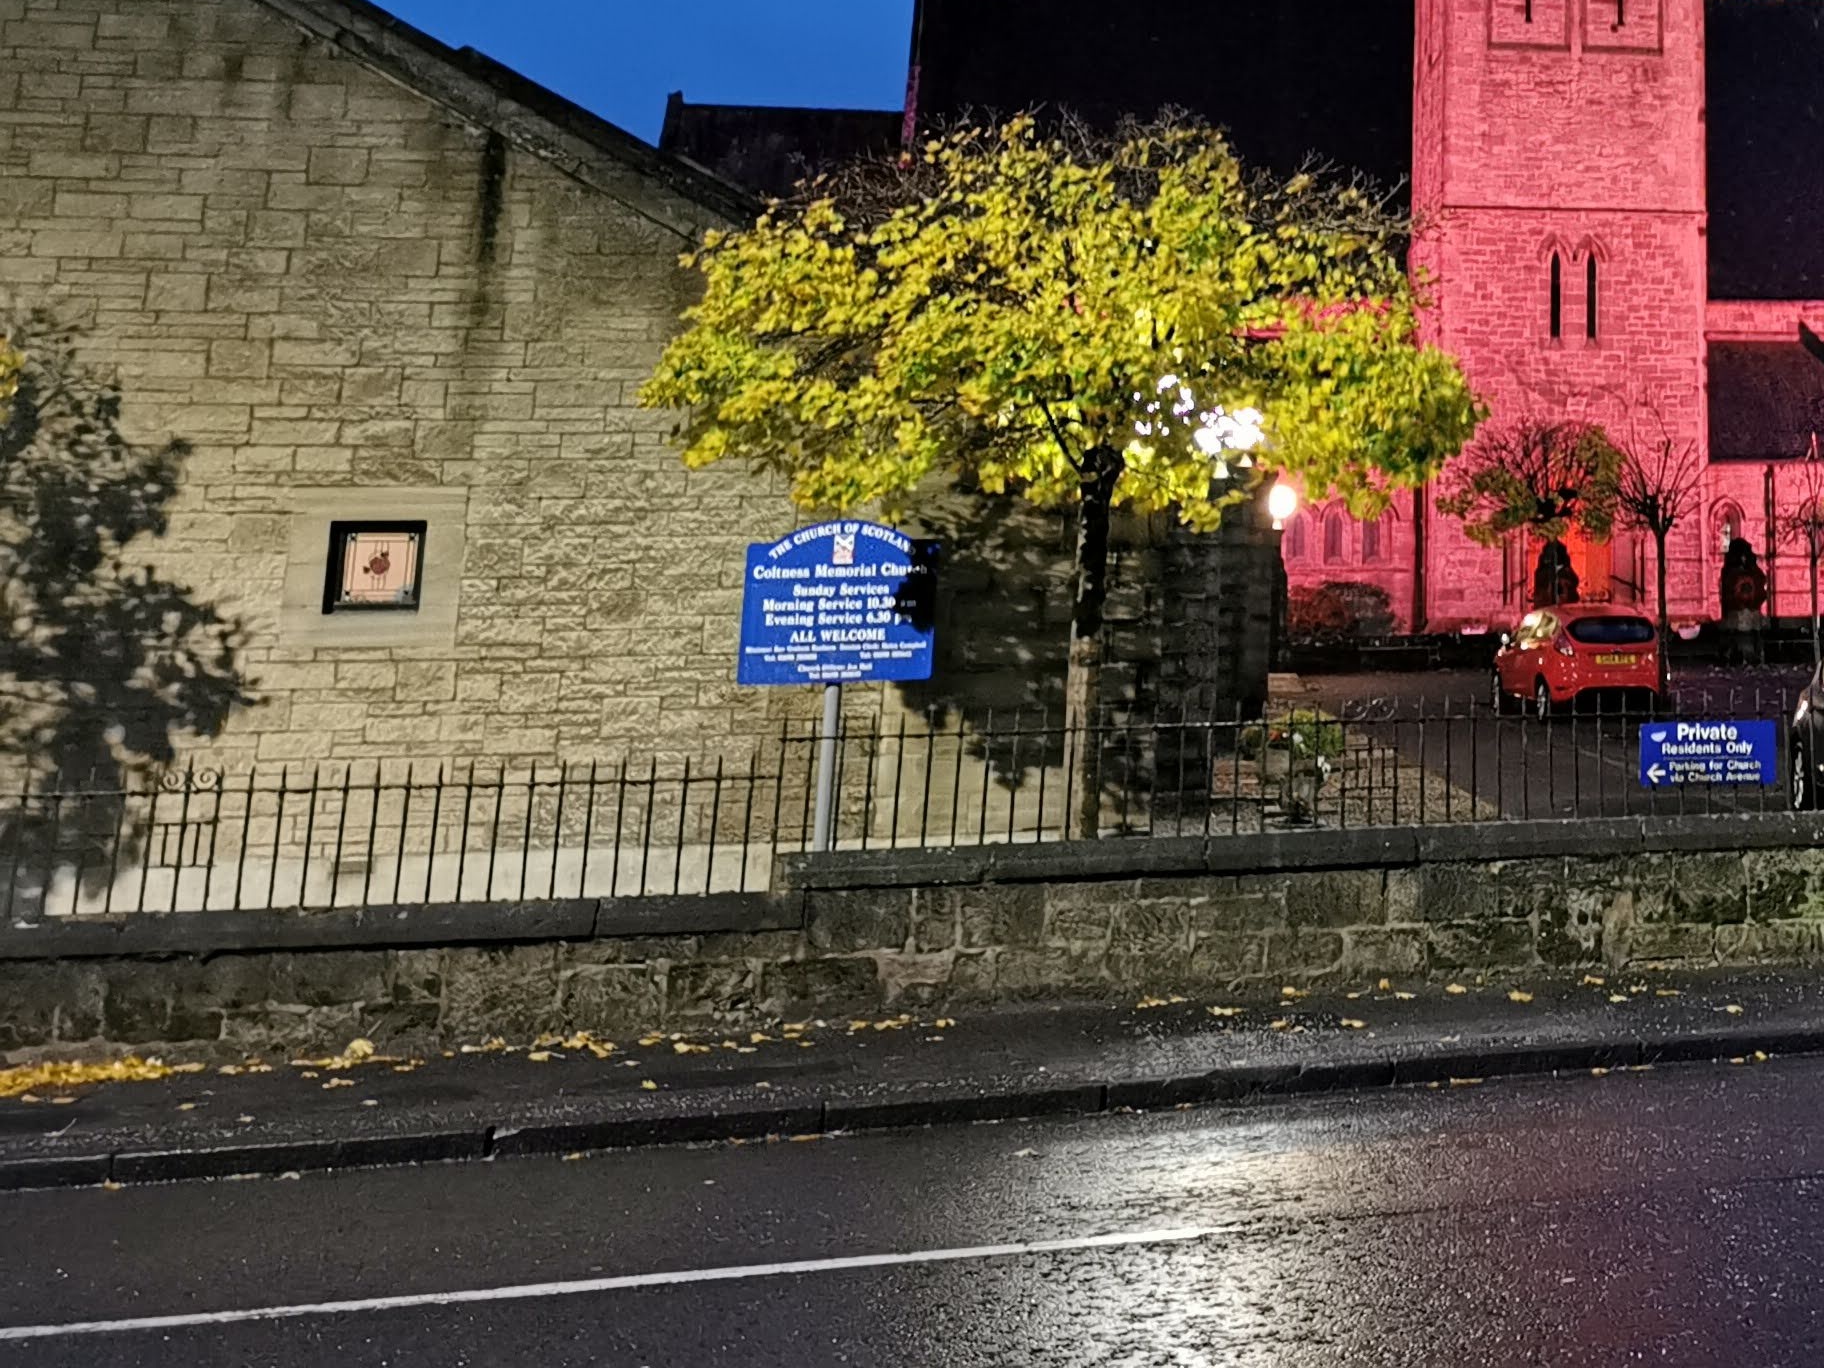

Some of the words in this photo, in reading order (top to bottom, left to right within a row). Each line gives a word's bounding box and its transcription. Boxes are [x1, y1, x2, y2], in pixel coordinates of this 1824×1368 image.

[768, 542, 792, 560] THE
[794, 524, 840, 545] CHURCH
[844, 523, 859, 533] OF
[753, 565, 810, 579] Coltness
[815, 564, 876, 577] Memorial
[793, 584, 835, 597] Sunday
[840, 583, 889, 595] Services
[763, 599, 813, 613] Morning
[818, 599, 862, 610] Service
[867, 596, 896, 608] 10.30
[766, 613, 813, 627] Evening
[818, 612, 862, 624] Service
[866, 611, 890, 623] 6.30
[790, 630, 816, 643] ALL
[821, 629, 885, 642] WELCOME
[1677, 723, 1737, 741] Private
[1662, 742, 1721, 755] Residents
[1726, 741, 1753, 755] Only
[1669, 761, 1706, 772] Parking
[1710, 760, 1723, 769] for
[1727, 760, 1761, 769] Church
[1670, 774, 1684, 782] via
[1688, 773, 1722, 781] Church
[1726, 772, 1760, 781] Avenue
